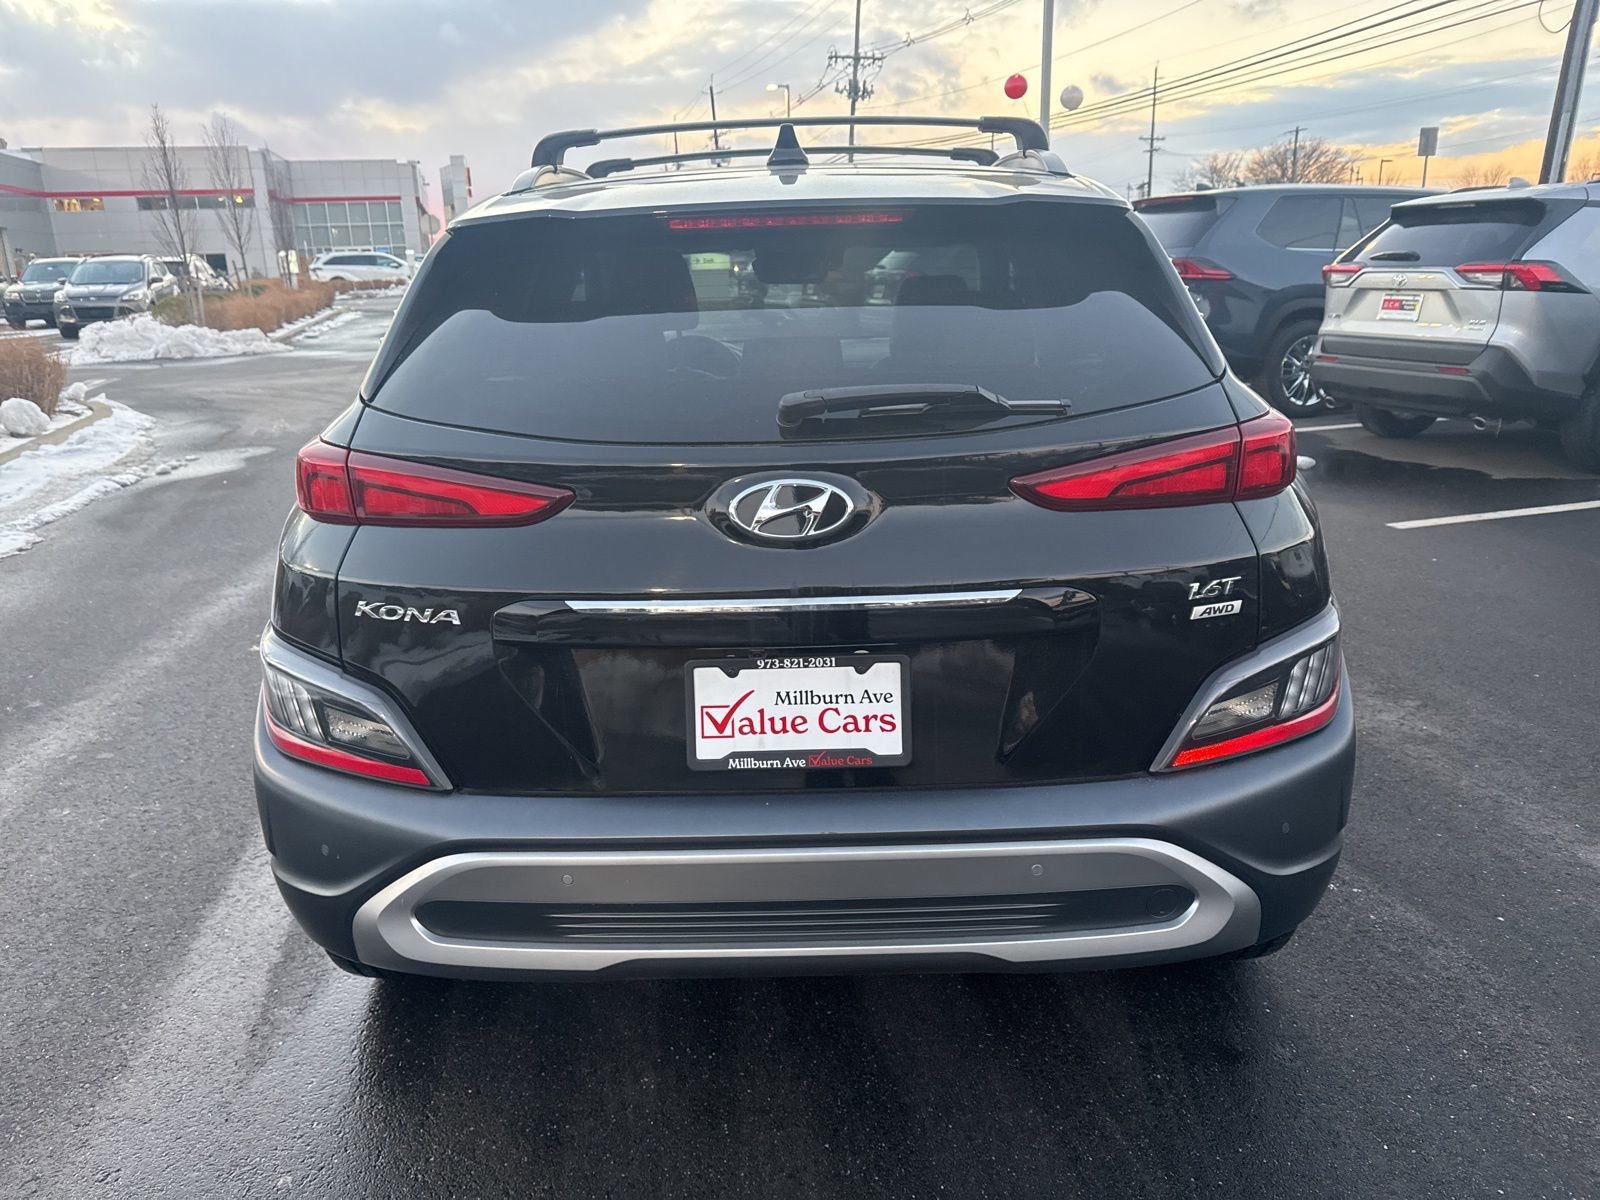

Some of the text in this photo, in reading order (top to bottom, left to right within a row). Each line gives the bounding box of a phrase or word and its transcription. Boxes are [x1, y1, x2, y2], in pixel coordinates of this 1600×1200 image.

[354, 600, 461, 625] KONA
[1199, 603, 1235, 617] AWD
[757, 657, 836, 669] 973-821-2031
[774, 689, 894, 706] Millburn Ave
[818, 707, 897, 734] Cars
[728, 757, 782, 769] Millburn
[783, 757, 806, 768] Ave
[847, 755, 873, 766] Cars
